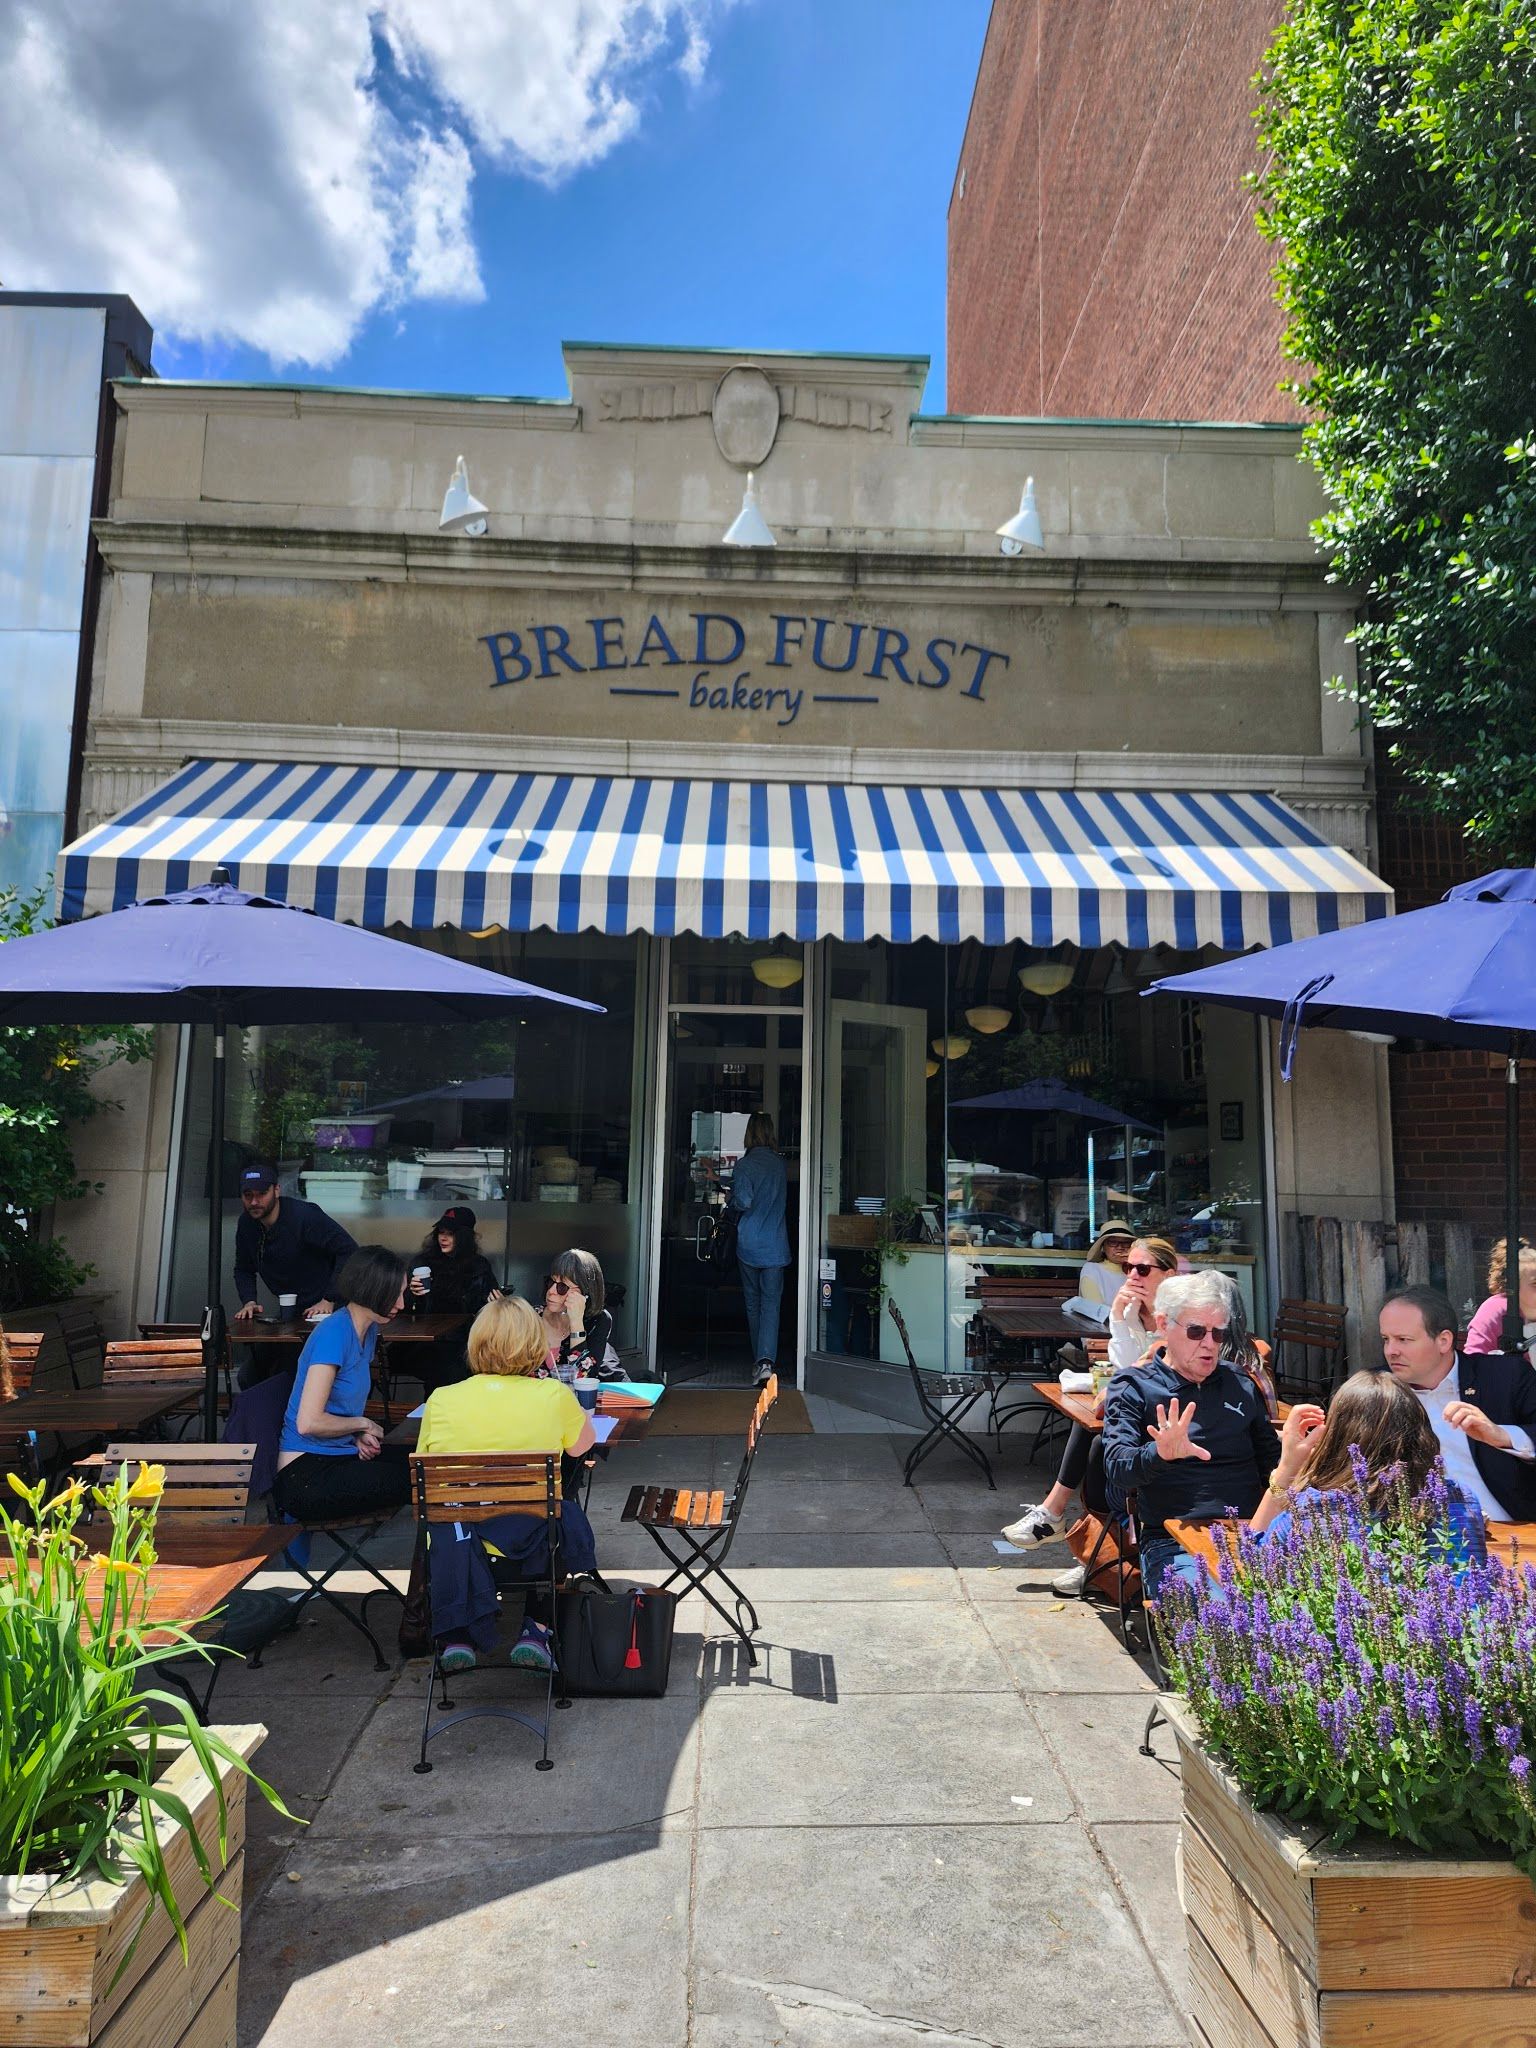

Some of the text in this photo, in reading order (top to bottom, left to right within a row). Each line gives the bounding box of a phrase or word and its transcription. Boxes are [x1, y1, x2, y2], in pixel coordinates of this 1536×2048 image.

[478, 613, 1010, 702] BREAD FURST
[689, 671, 804, 727] bakery
